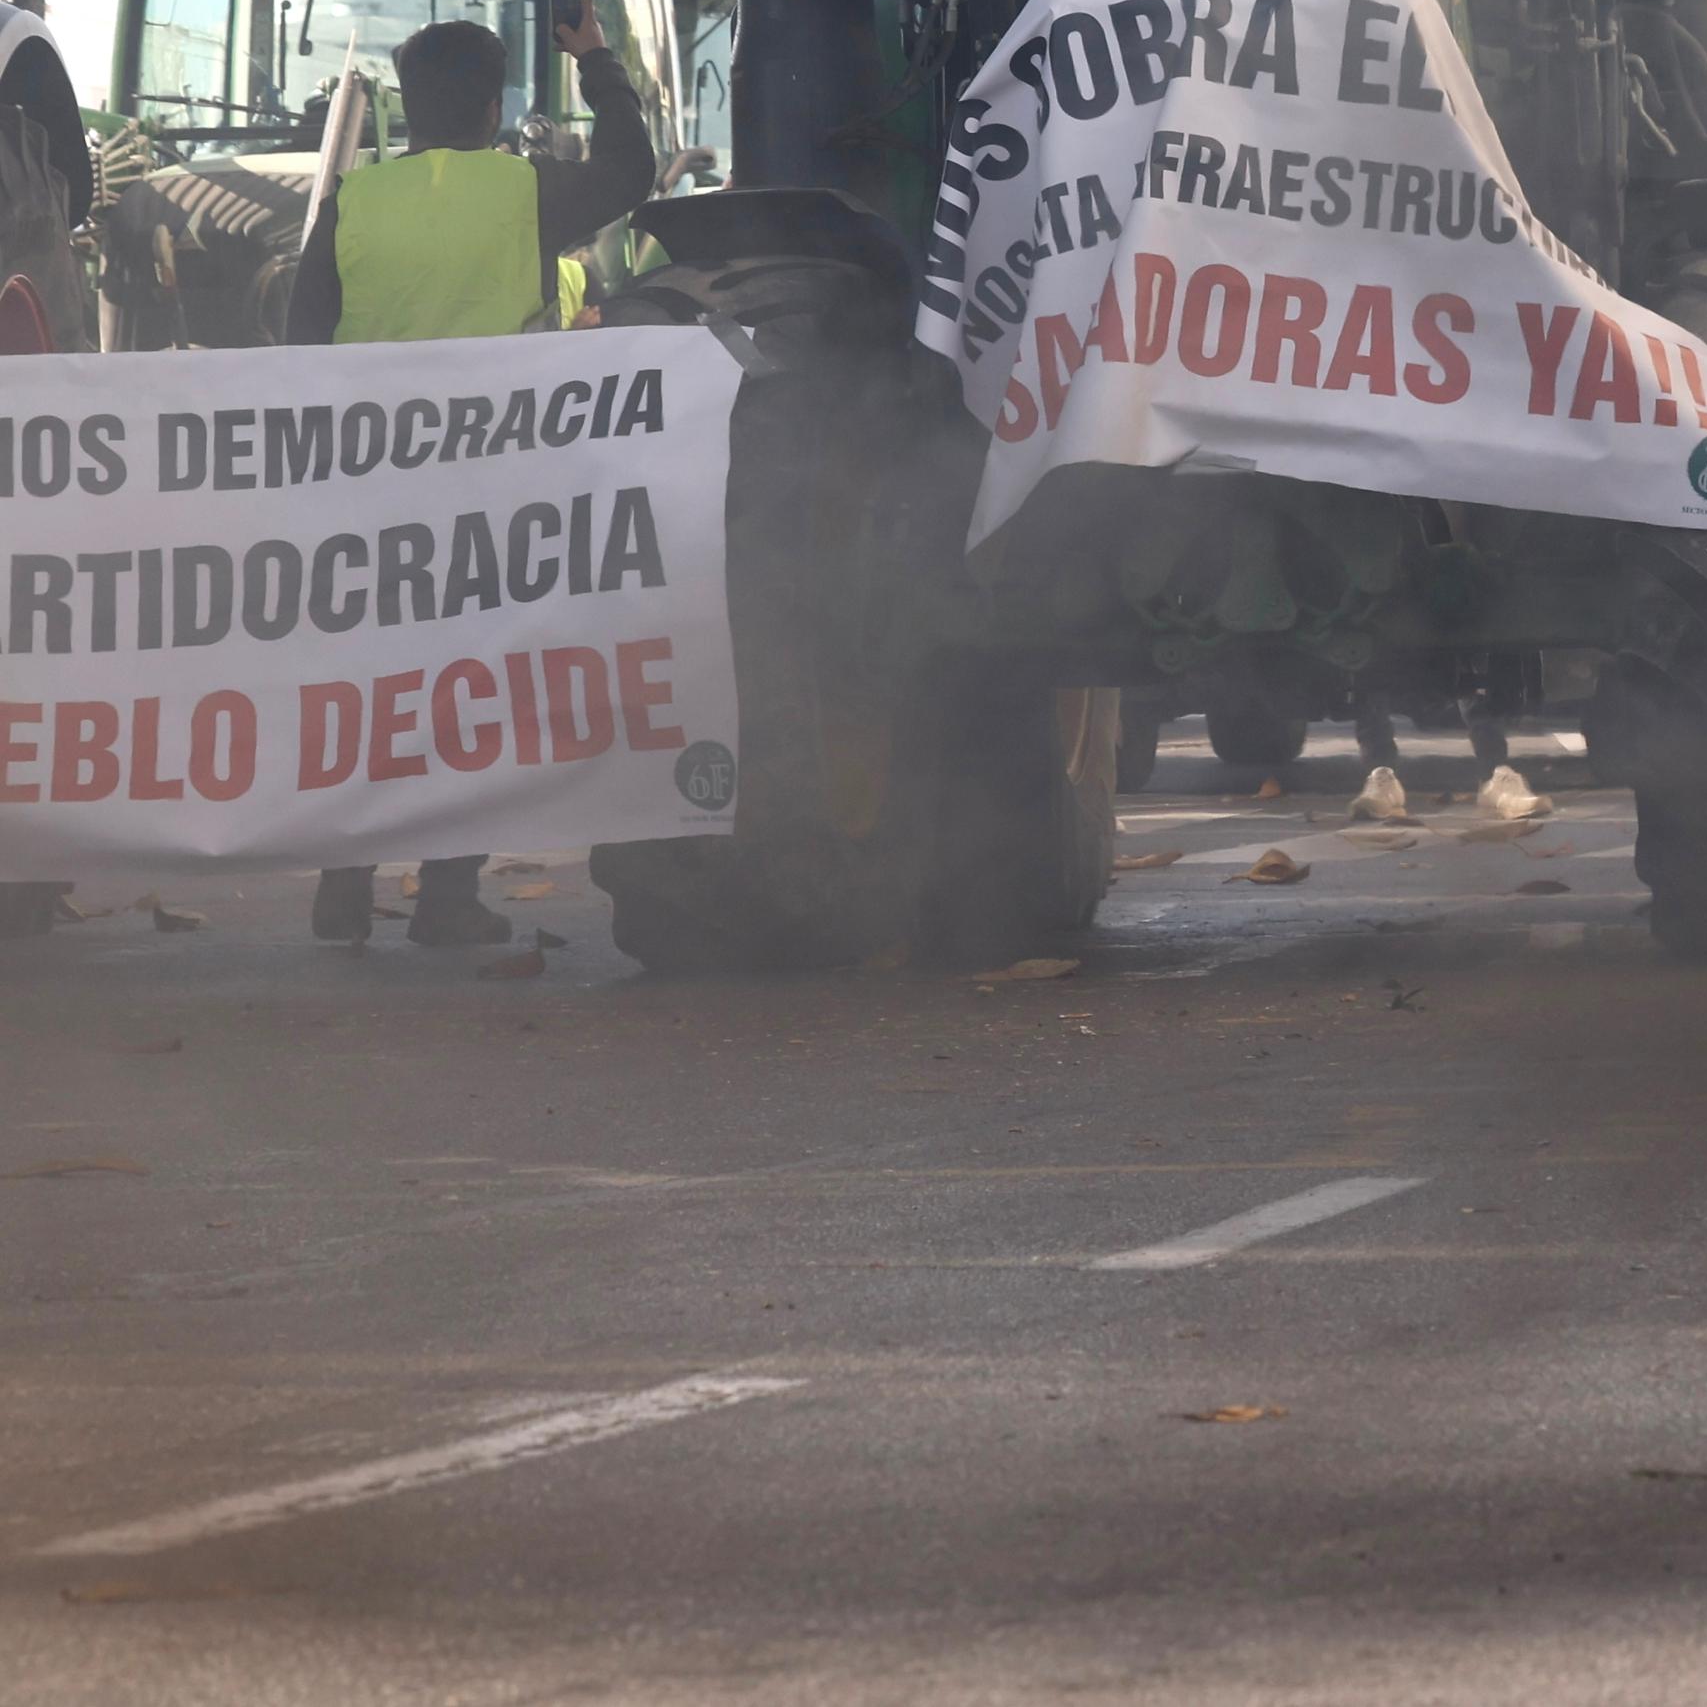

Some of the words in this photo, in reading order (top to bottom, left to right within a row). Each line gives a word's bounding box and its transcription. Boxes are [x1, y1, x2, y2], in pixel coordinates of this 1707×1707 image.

[0, 414, 127, 498] OS
[158, 369, 664, 493] DEMOCRACIA
[0, 486, 666, 654] RTIDOCRACIA
[297, 637, 686, 791] DECIDE
